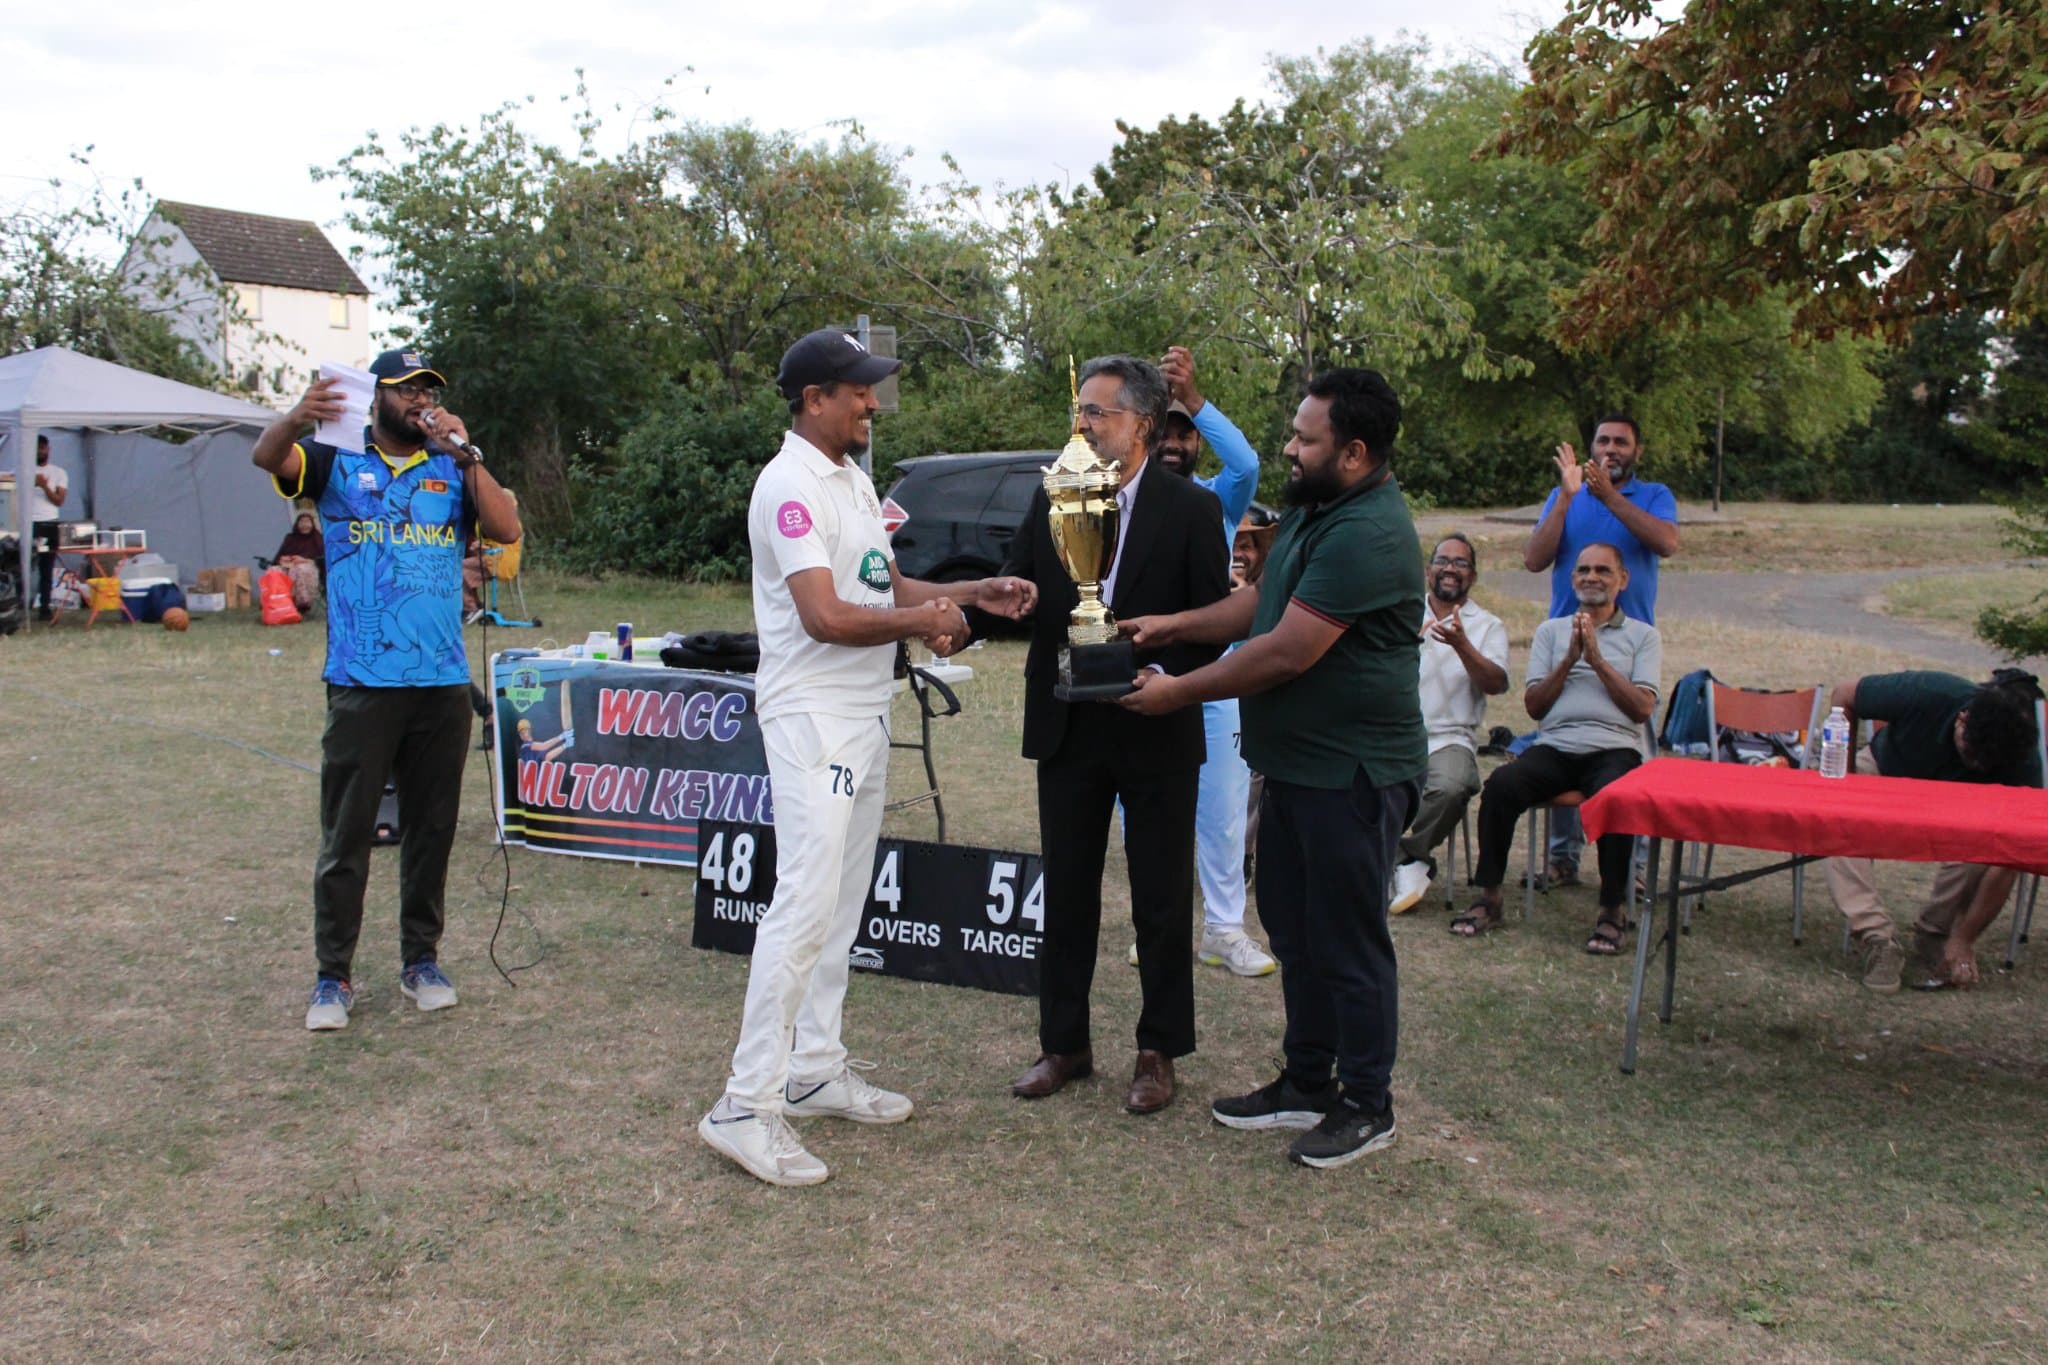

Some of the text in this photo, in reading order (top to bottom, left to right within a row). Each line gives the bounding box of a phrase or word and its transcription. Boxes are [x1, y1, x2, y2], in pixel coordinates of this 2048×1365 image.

[349, 521, 456, 547] SRI LANKA
[597, 688, 747, 742] WMCC
[518, 759, 649, 815] MILTON
[830, 764, 854, 797] 78
[701, 831, 755, 893] 48
[874, 850, 902, 913] 4
[713, 897, 767, 924] RUNS
[986, 861, 1045, 932] 54
[868, 917, 941, 948] OVERS
